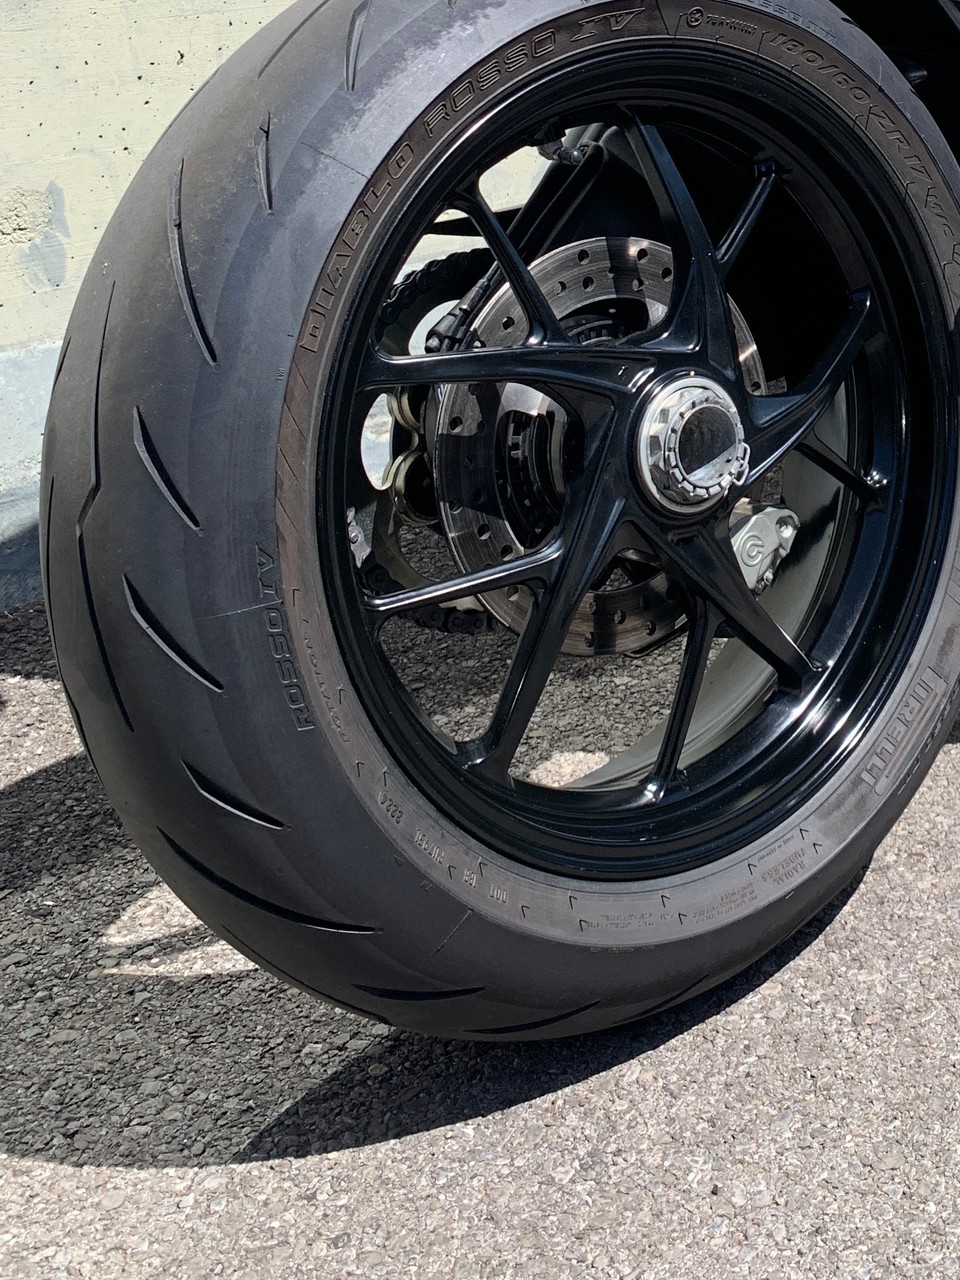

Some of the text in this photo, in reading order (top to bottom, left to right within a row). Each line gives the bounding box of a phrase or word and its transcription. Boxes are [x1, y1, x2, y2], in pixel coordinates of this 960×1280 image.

[769, 32, 871, 106] 180/60
[300, 7, 646, 354] DIABLO ROSSO IV
[263, 607, 316, 732] ROSSO
[861, 666, 949, 795] PIRELLI
